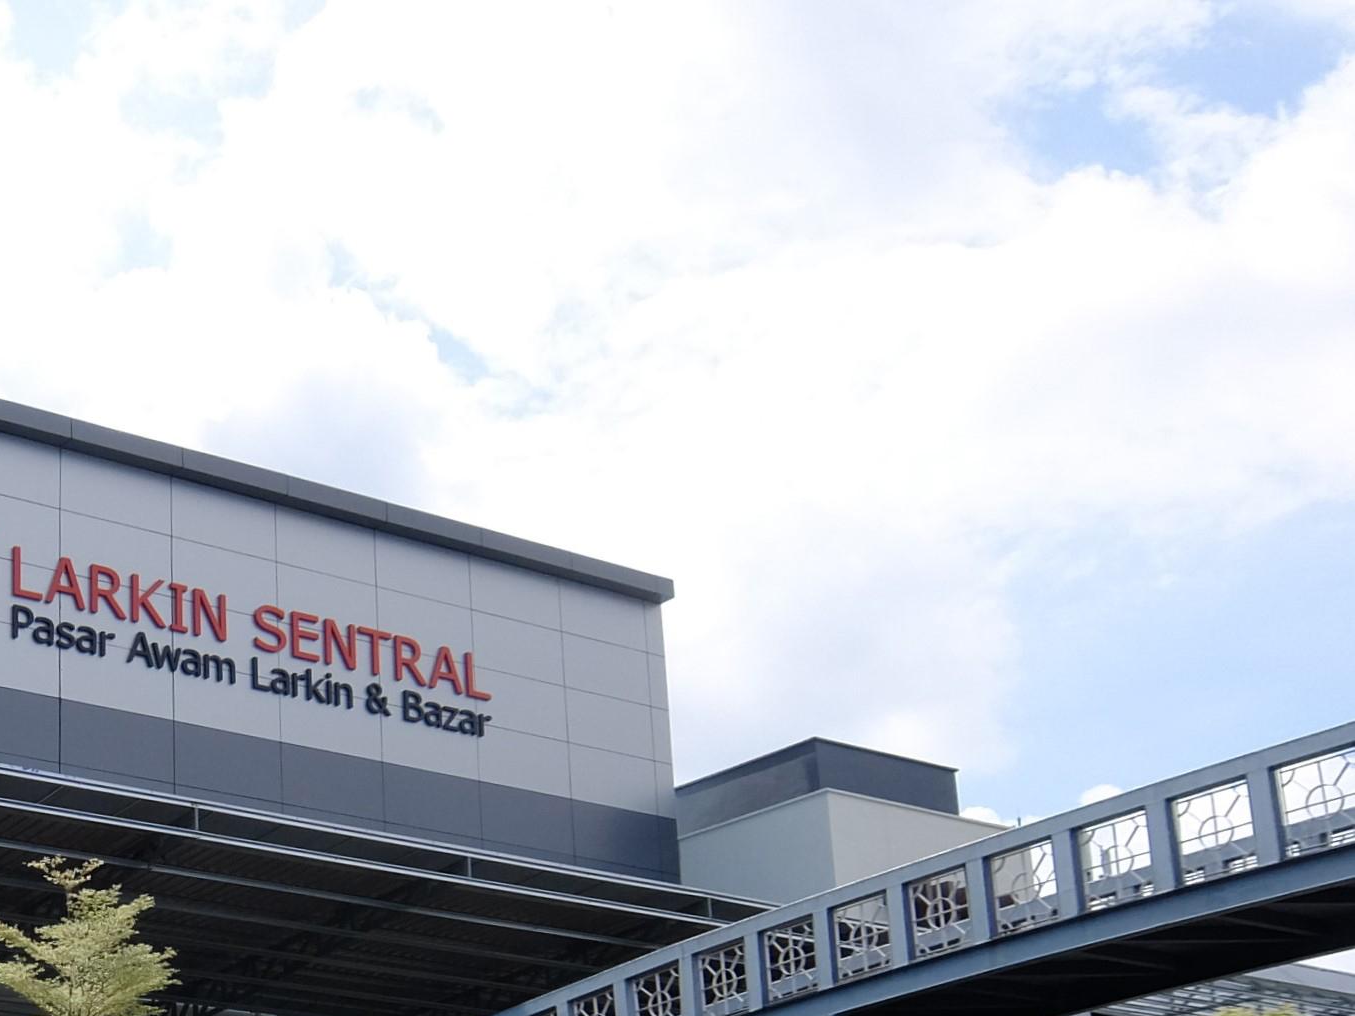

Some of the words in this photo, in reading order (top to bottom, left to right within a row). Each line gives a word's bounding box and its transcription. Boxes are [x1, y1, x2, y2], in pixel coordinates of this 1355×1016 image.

[11, 546, 226, 642] LARKIN
[253, 604, 492, 701] SENTRAL
[11, 604, 115, 658] Pasar
[126, 631, 236, 685] Awam
[251, 656, 354, 709] Larkin
[365, 681, 391, 717] &
[402, 689, 492, 738] Bazar
